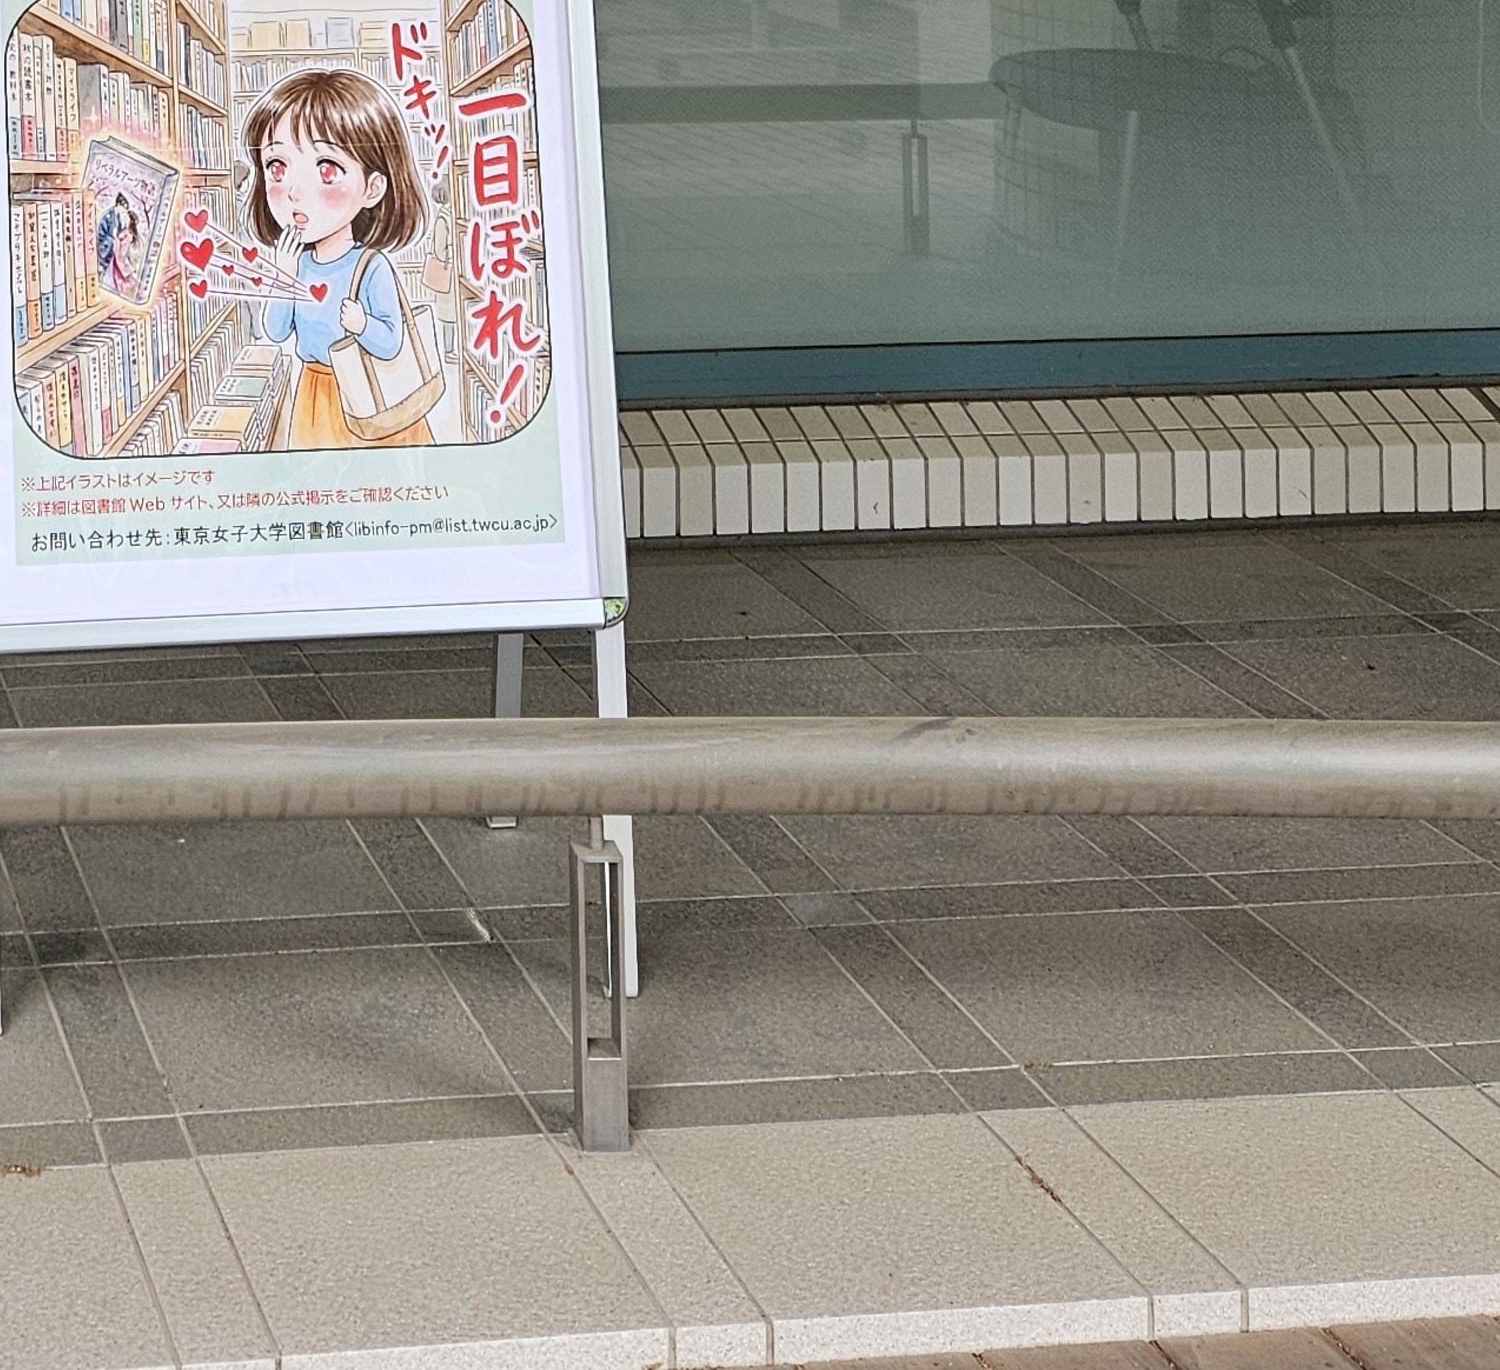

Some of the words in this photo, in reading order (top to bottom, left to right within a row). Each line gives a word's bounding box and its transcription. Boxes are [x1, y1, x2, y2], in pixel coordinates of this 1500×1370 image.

[458, 92, 542, 425] 一目ぼれ！
[21, 469, 215, 492] ※上記イラストはイメージです
